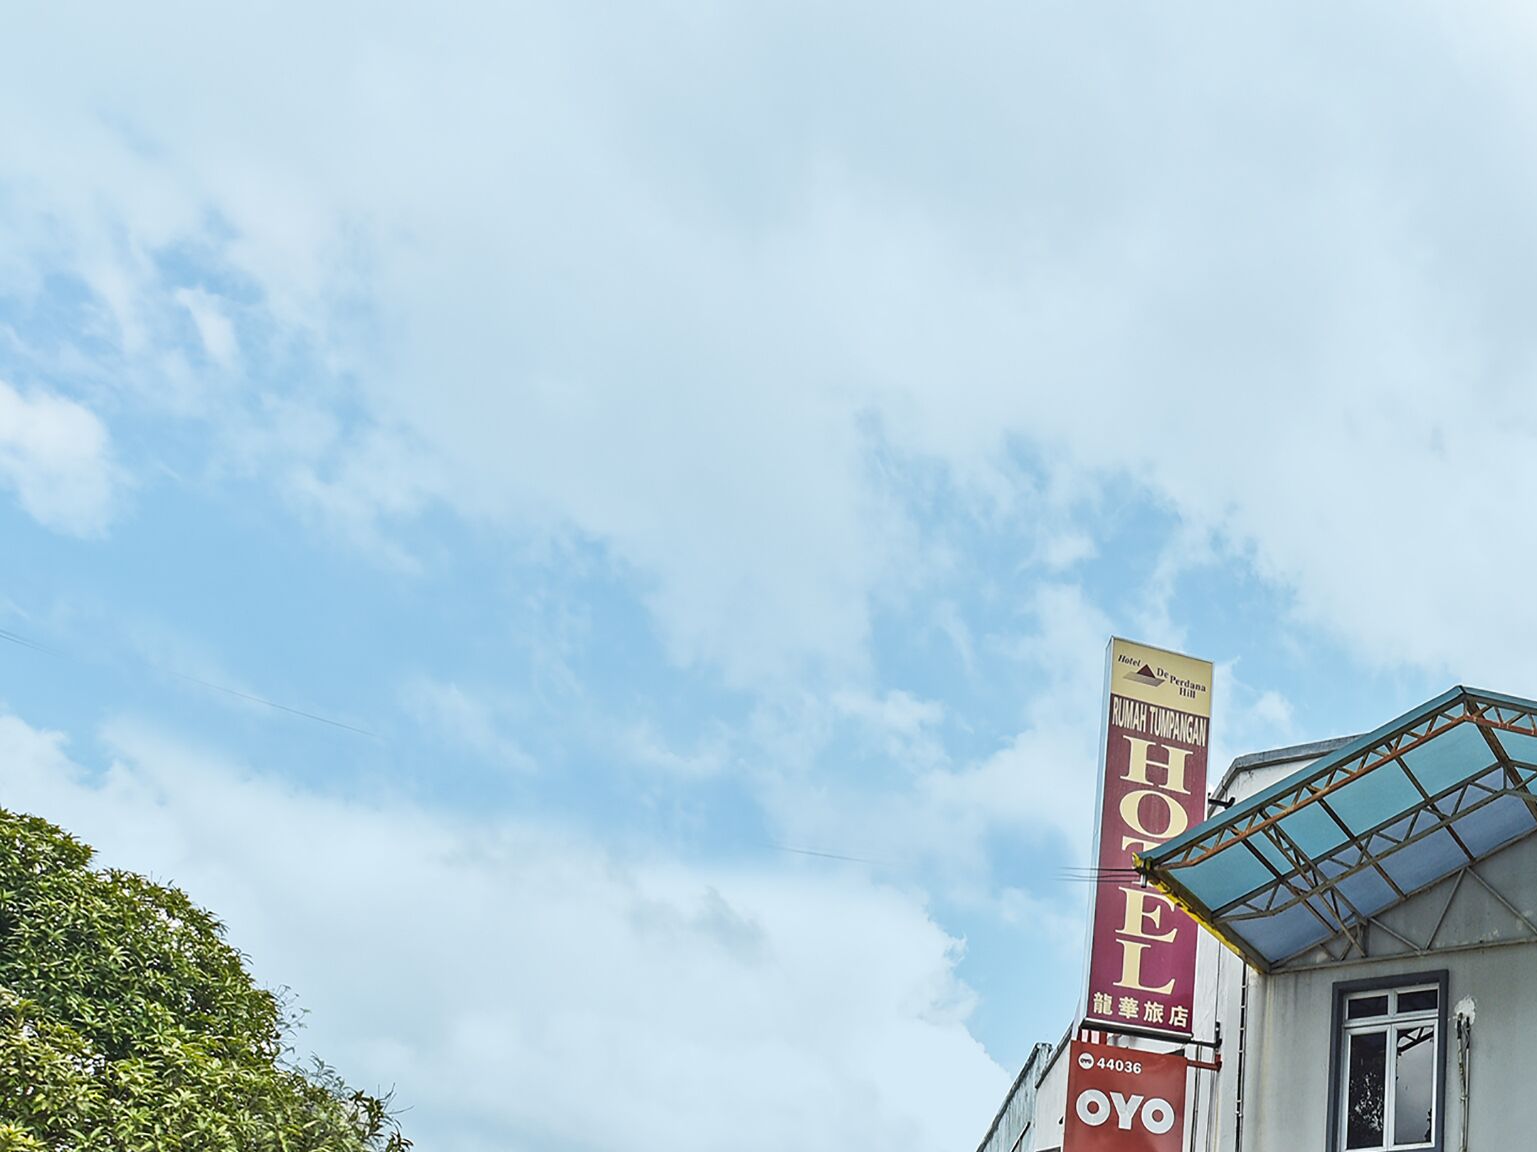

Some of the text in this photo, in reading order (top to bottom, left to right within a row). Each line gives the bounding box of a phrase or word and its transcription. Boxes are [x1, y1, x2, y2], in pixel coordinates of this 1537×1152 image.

[1118, 654, 1141, 667] Hotel
[1156, 668, 1206, 692] De Perdana
[1179, 687, 1196, 699] Hill
[1112, 697, 1207, 747] RUMAH TUMPANGAN
[1093, 992, 1189, 1029] 龍華旅店
[1096, 1058, 1142, 1074] 44036
[1076, 1088, 1175, 1135] OYO
